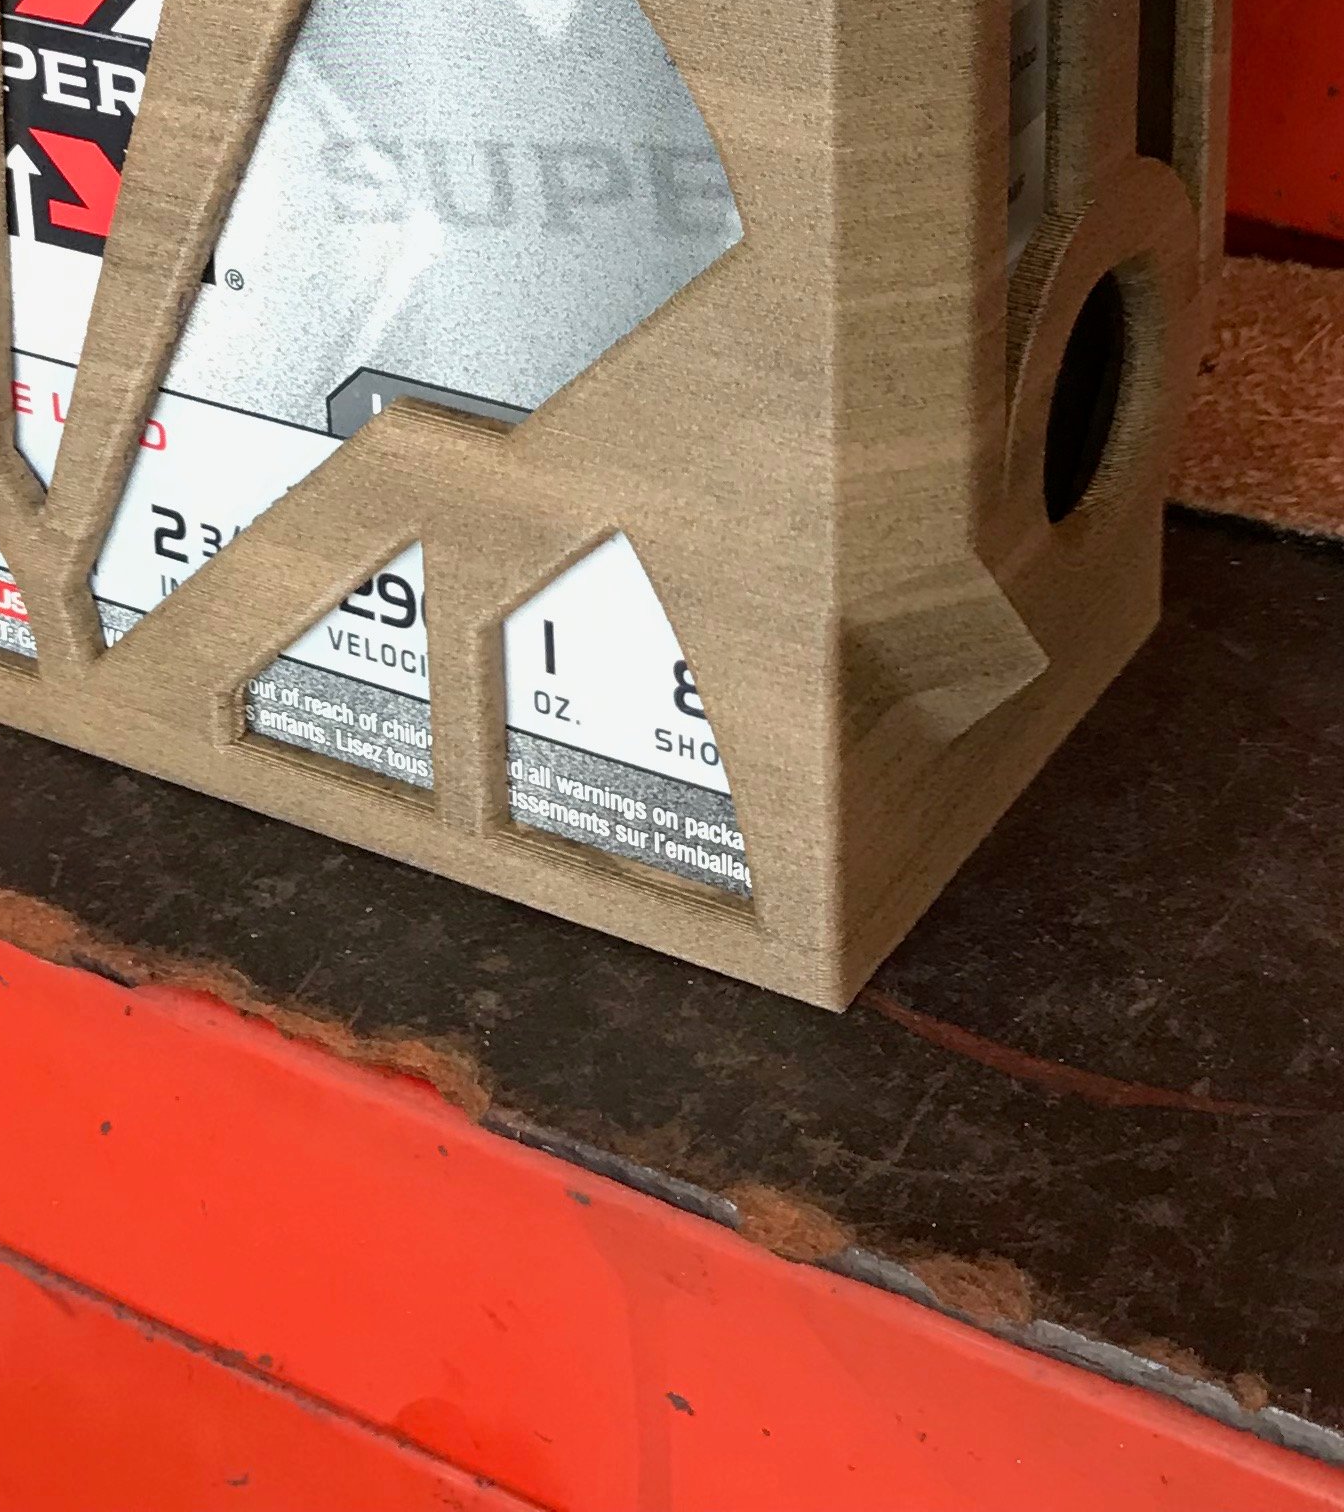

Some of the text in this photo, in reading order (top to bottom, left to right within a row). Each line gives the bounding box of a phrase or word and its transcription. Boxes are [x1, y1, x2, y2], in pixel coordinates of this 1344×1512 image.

[151, 504, 189, 564] 2
[248, 678, 278, 702] out
[281, 687, 300, 708] of
[304, 695, 355, 726] reach
[359, 711, 378, 733] of
[534, 689, 581, 726] OZ.
[259, 709, 332, 746] enfants.
[335, 728, 383, 763] Lisez
[387, 746, 428, 777] tous
[528, 765, 551, 789] all
[556, 775, 647, 821] warnings
[652, 805, 679, 831] on
[615, 824, 649, 849] sur
